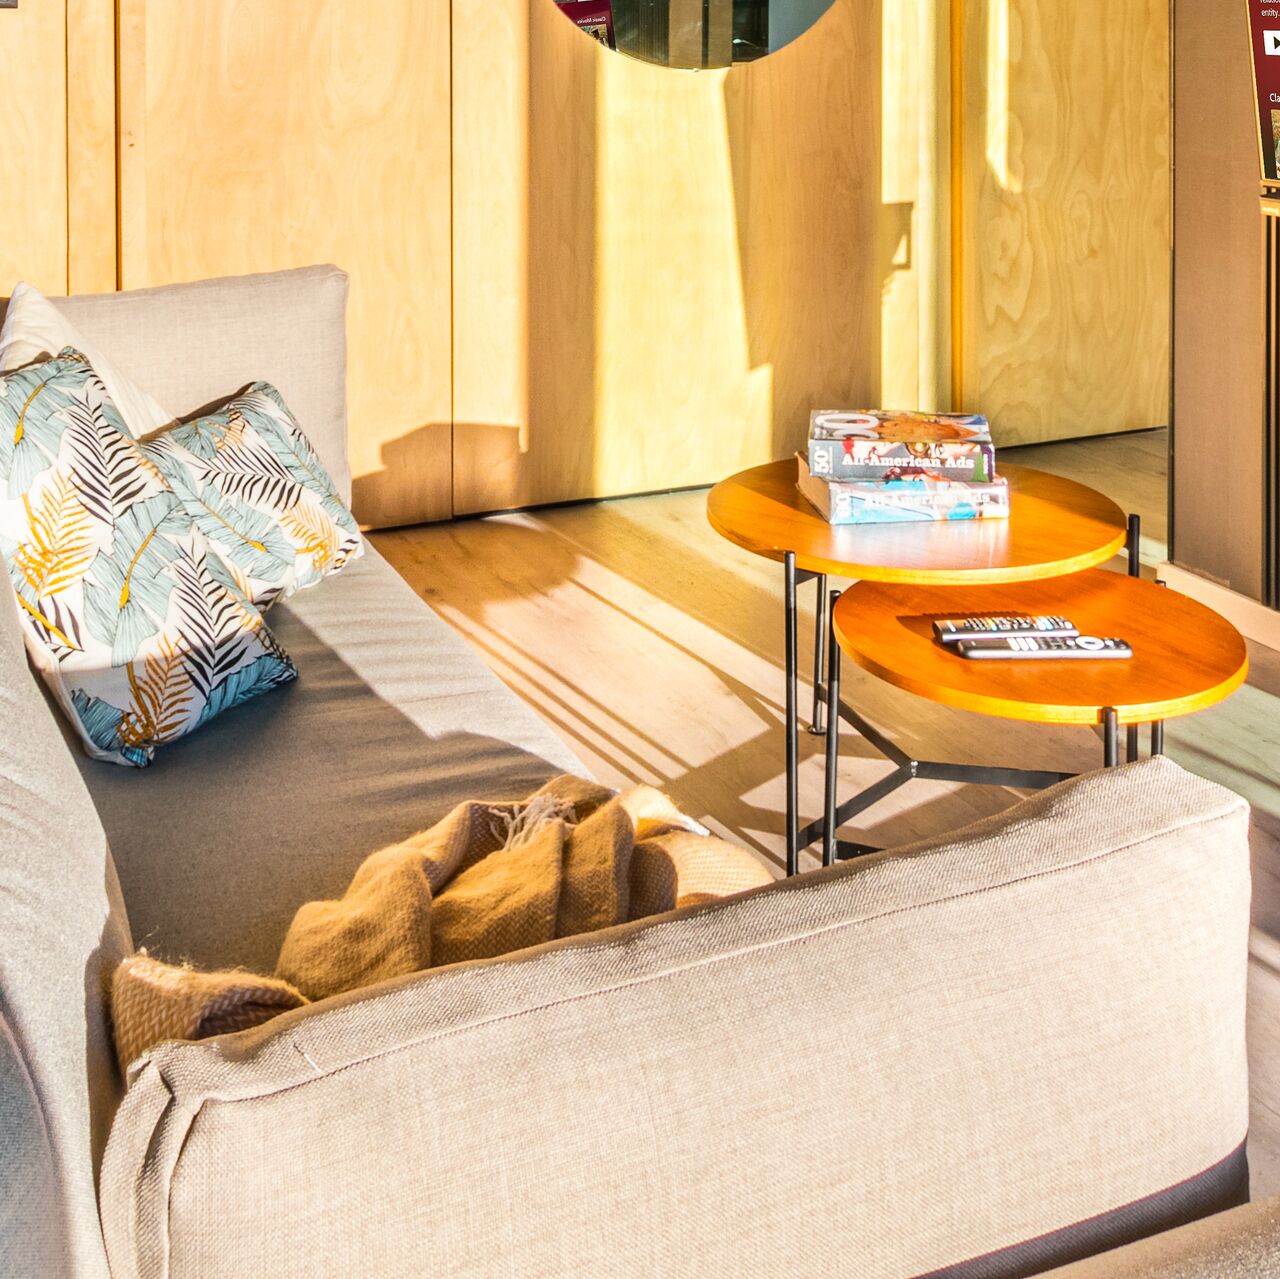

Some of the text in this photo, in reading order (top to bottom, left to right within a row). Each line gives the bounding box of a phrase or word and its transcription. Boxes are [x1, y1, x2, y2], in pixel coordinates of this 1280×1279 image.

[1261, 8, 1280, 18] entity.
[841, 453, 942, 468] All-American
[945, 456, 975, 469] Ads
